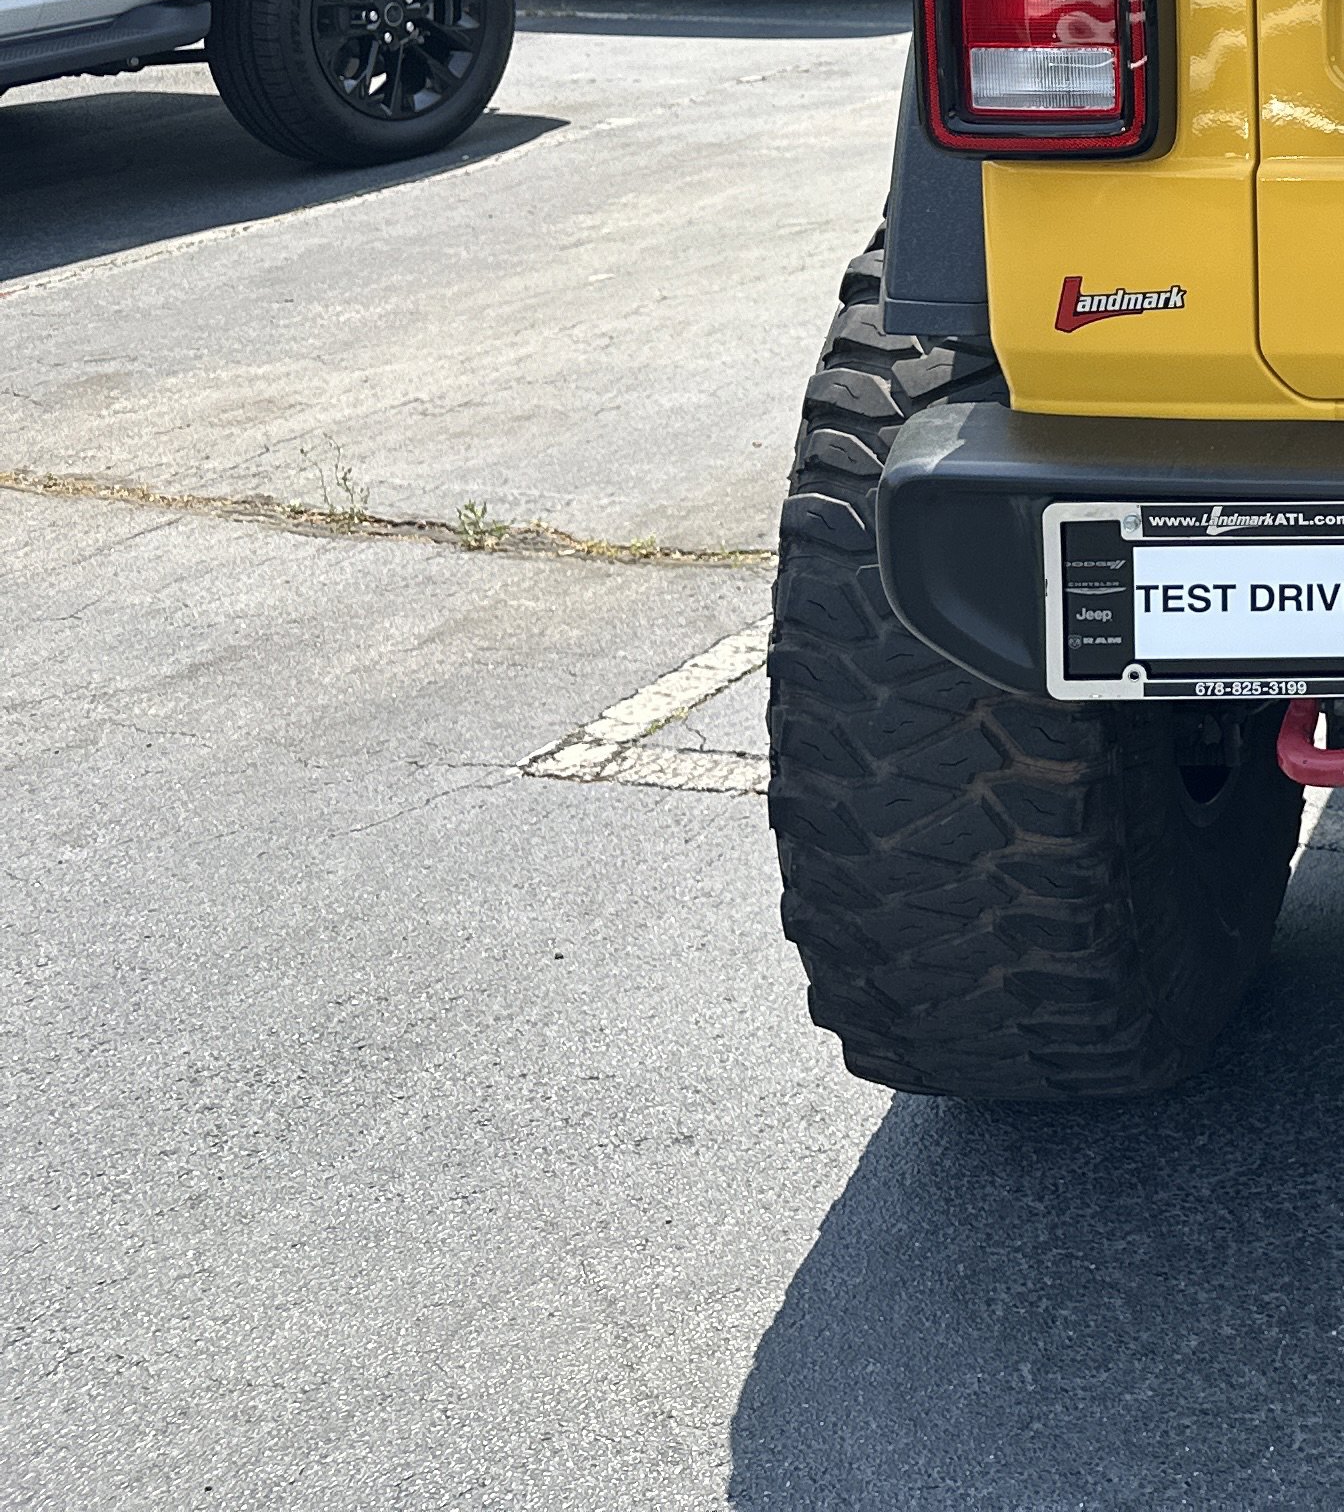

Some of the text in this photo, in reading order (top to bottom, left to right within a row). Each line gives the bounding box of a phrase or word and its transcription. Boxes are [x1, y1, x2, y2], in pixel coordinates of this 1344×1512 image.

[1054, 275, 1187, 334] Landmark
[1136, 584, 1237, 613] TEST
[1075, 607, 1112, 622] Jeep
[1195, 681, 1308, 696] 678-825-3199
